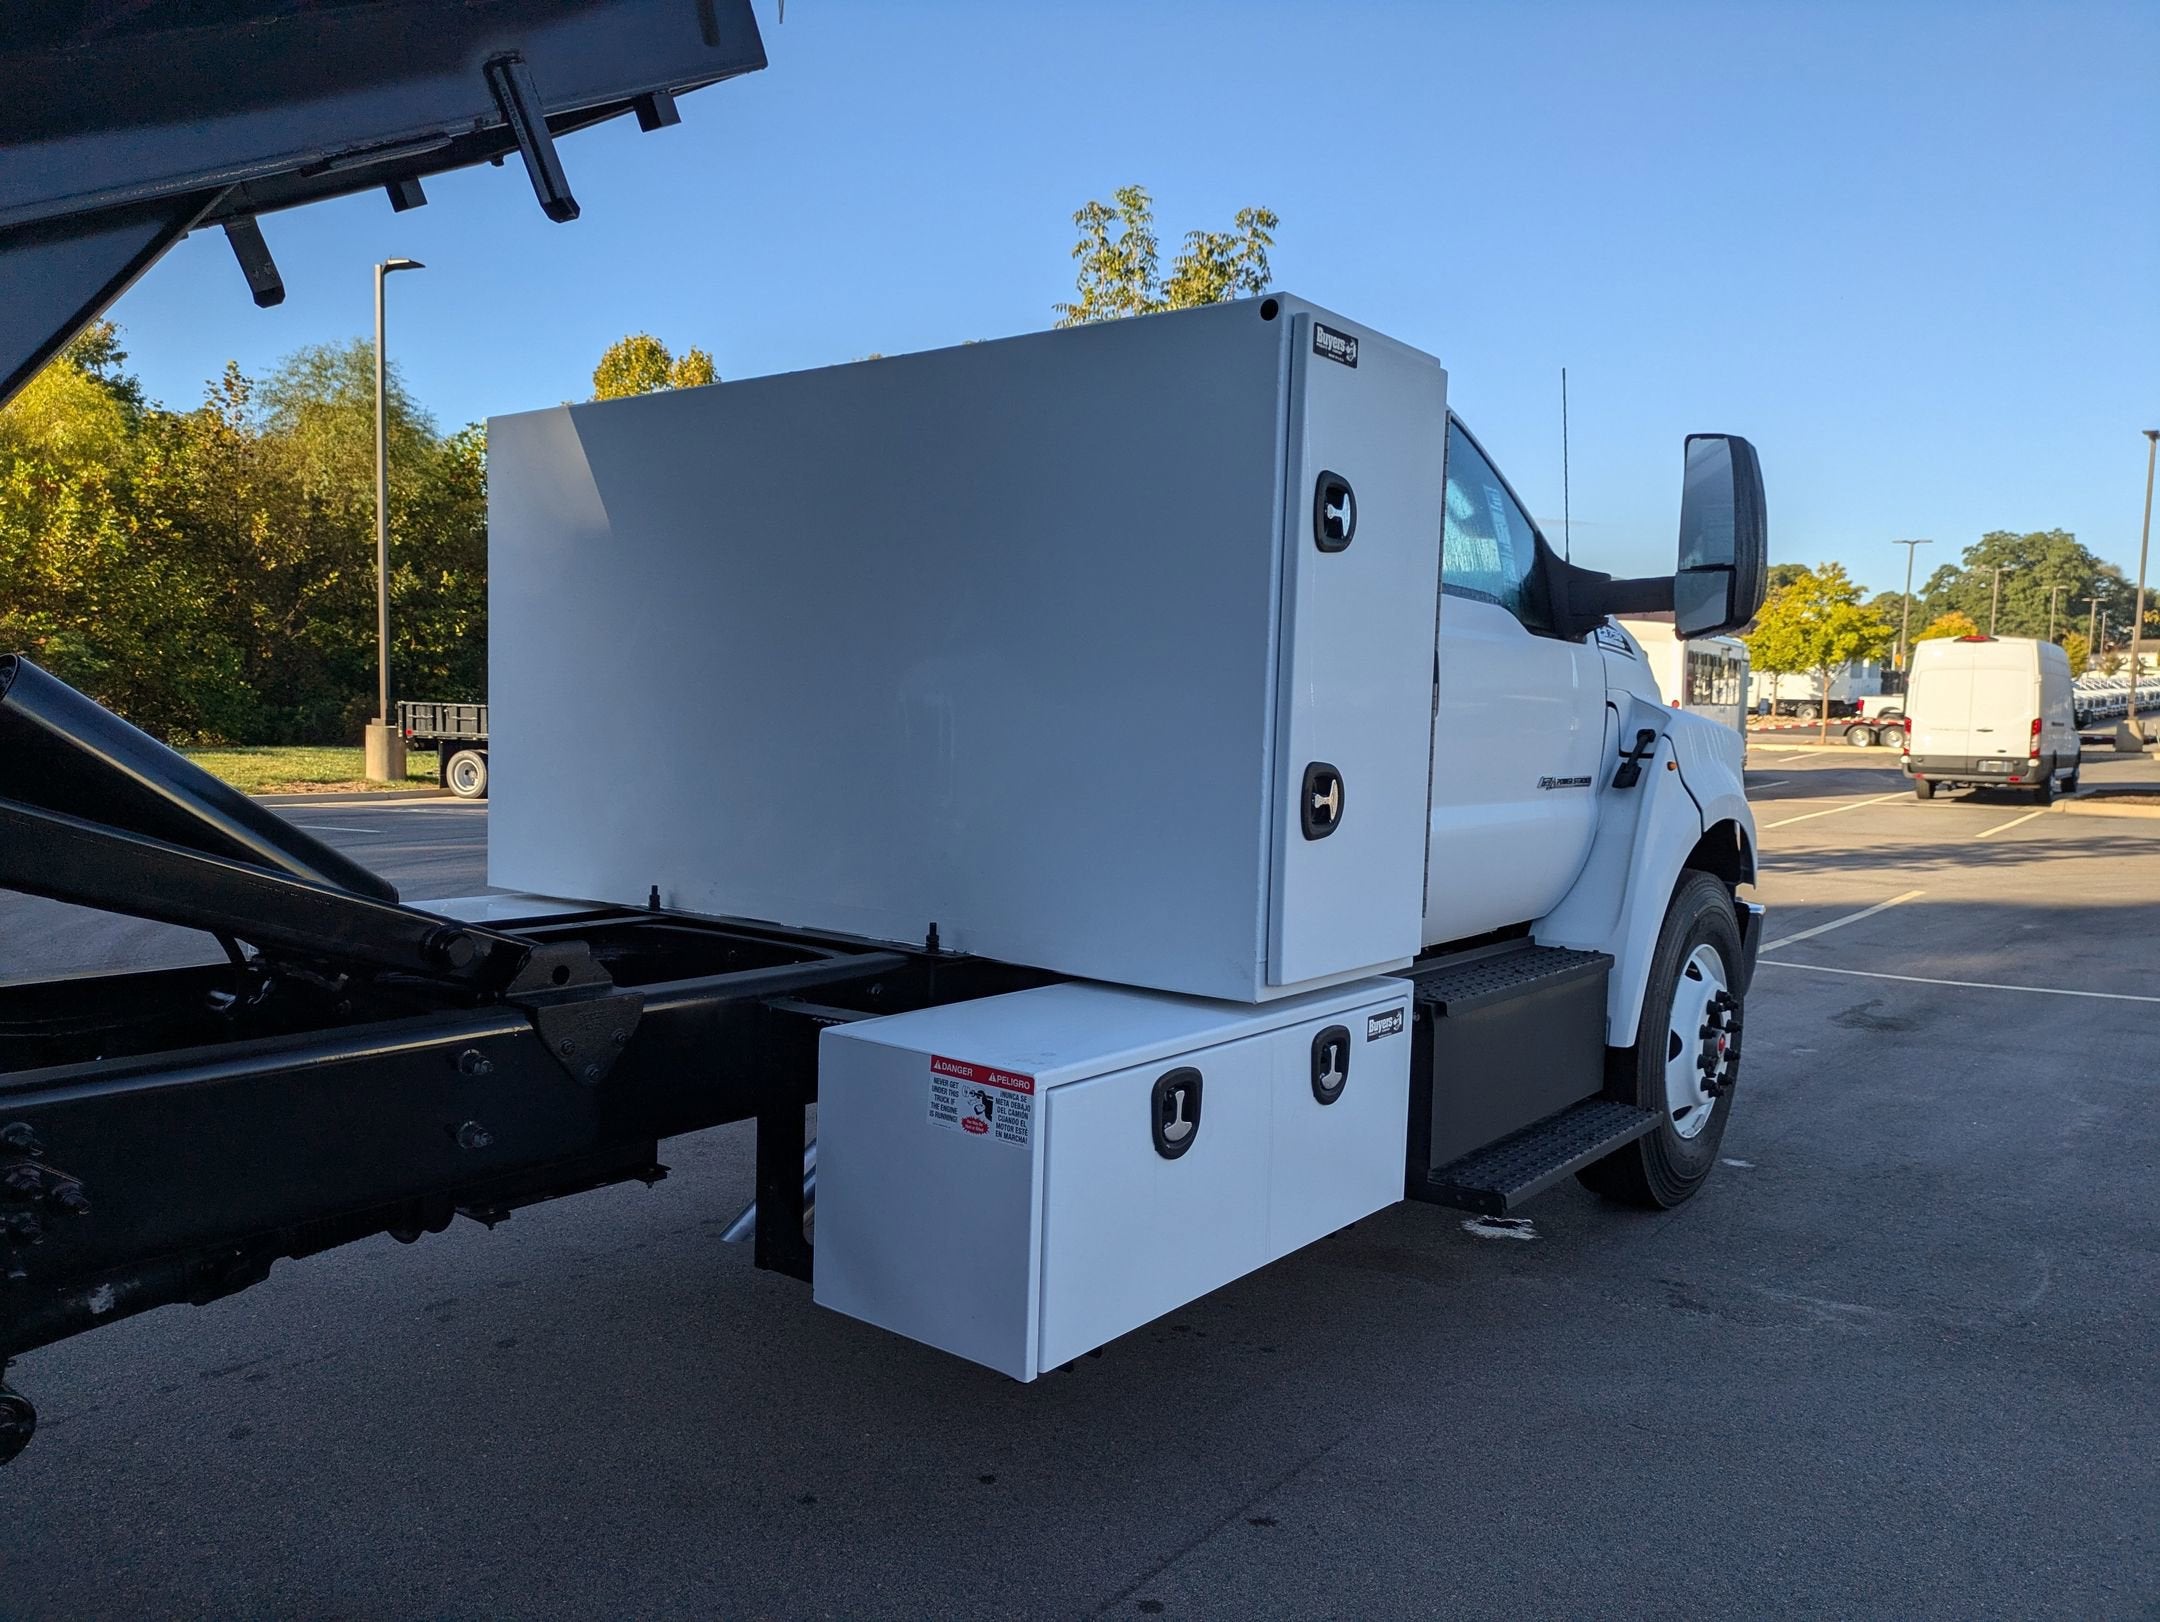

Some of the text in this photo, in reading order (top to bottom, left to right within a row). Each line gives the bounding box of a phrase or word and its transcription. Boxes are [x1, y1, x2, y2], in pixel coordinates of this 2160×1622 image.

[1316, 326, 1346, 352] Buyers
[1369, 1016, 1393, 1033] Buyers
[942, 1062, 973, 1077] DANGER
[934, 1077, 959, 1089] NEVER GET
[997, 1075, 1030, 1090] PELIGRO
[932, 1085, 959, 1098] UNDER THIS
[934, 1094, 950, 1104] TRUCK
[995, 1097, 1031, 1112] META DEBAJO
[931, 1102, 940, 1110] THE
[997, 1106, 1007, 1115] DEL
[998, 1114, 1019, 1125] CUANDO
[995, 1122, 1014, 1133] MOTOR
